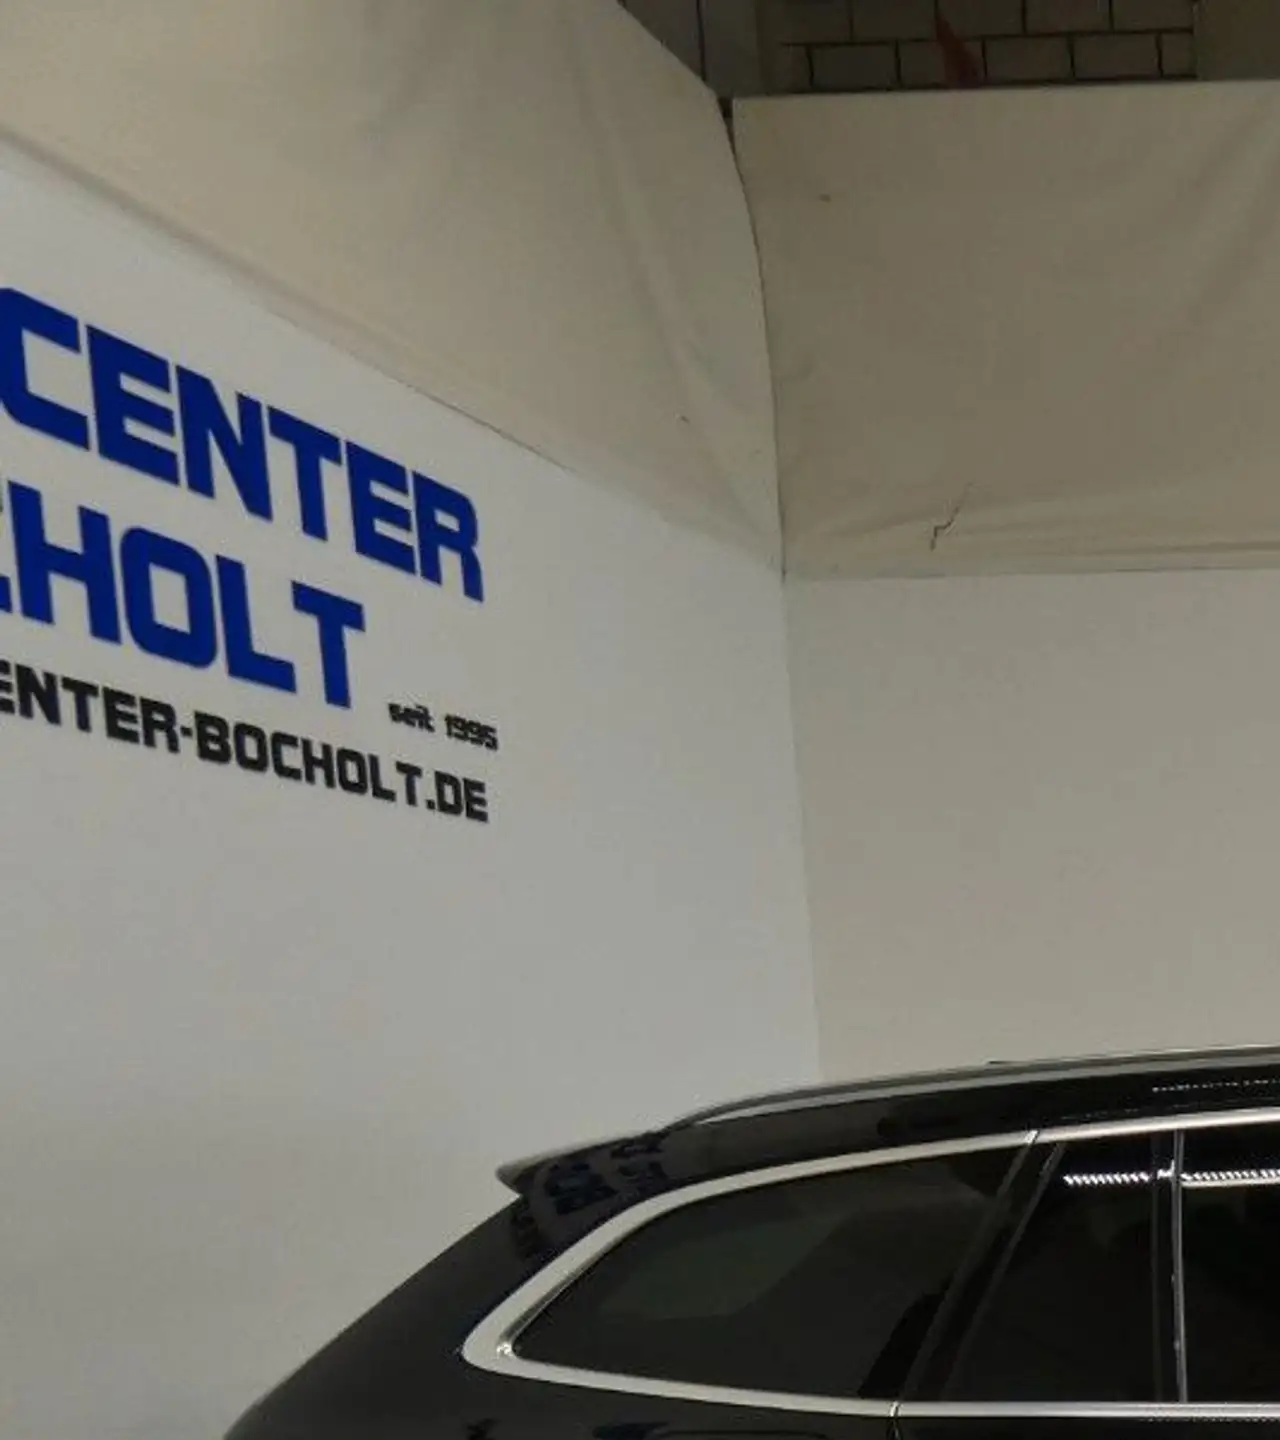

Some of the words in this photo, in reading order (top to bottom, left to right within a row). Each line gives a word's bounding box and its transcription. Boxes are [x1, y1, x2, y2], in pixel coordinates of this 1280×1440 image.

[0, 288, 483, 602] CENTER
[0, 480, 365, 708] HOLT
[444, 714, 499, 751] 1995
